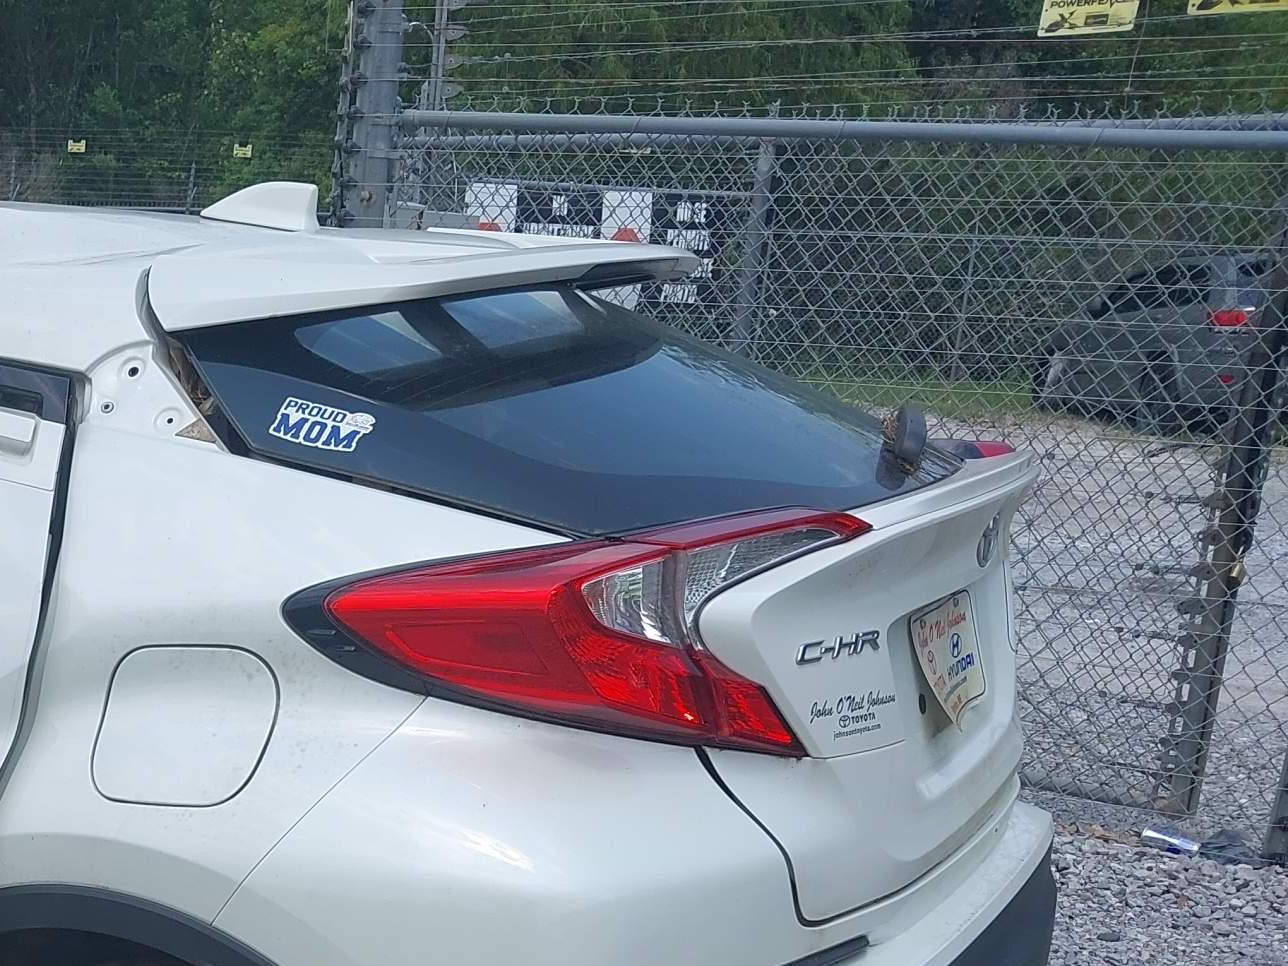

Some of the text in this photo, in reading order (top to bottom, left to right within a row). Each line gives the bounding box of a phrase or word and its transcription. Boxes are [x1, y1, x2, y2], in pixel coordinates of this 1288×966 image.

[283, 399, 348, 423] PROUD
[273, 412, 361, 449] MOM
[796, 630, 880, 666] C-HR
[947, 652, 975, 682] HYUNDAI
[809, 689, 896, 724] John O'Neil Johnson
[851, 711, 876, 725] TOYOTA
[833, 722, 881, 741] johnsontoyota.com
